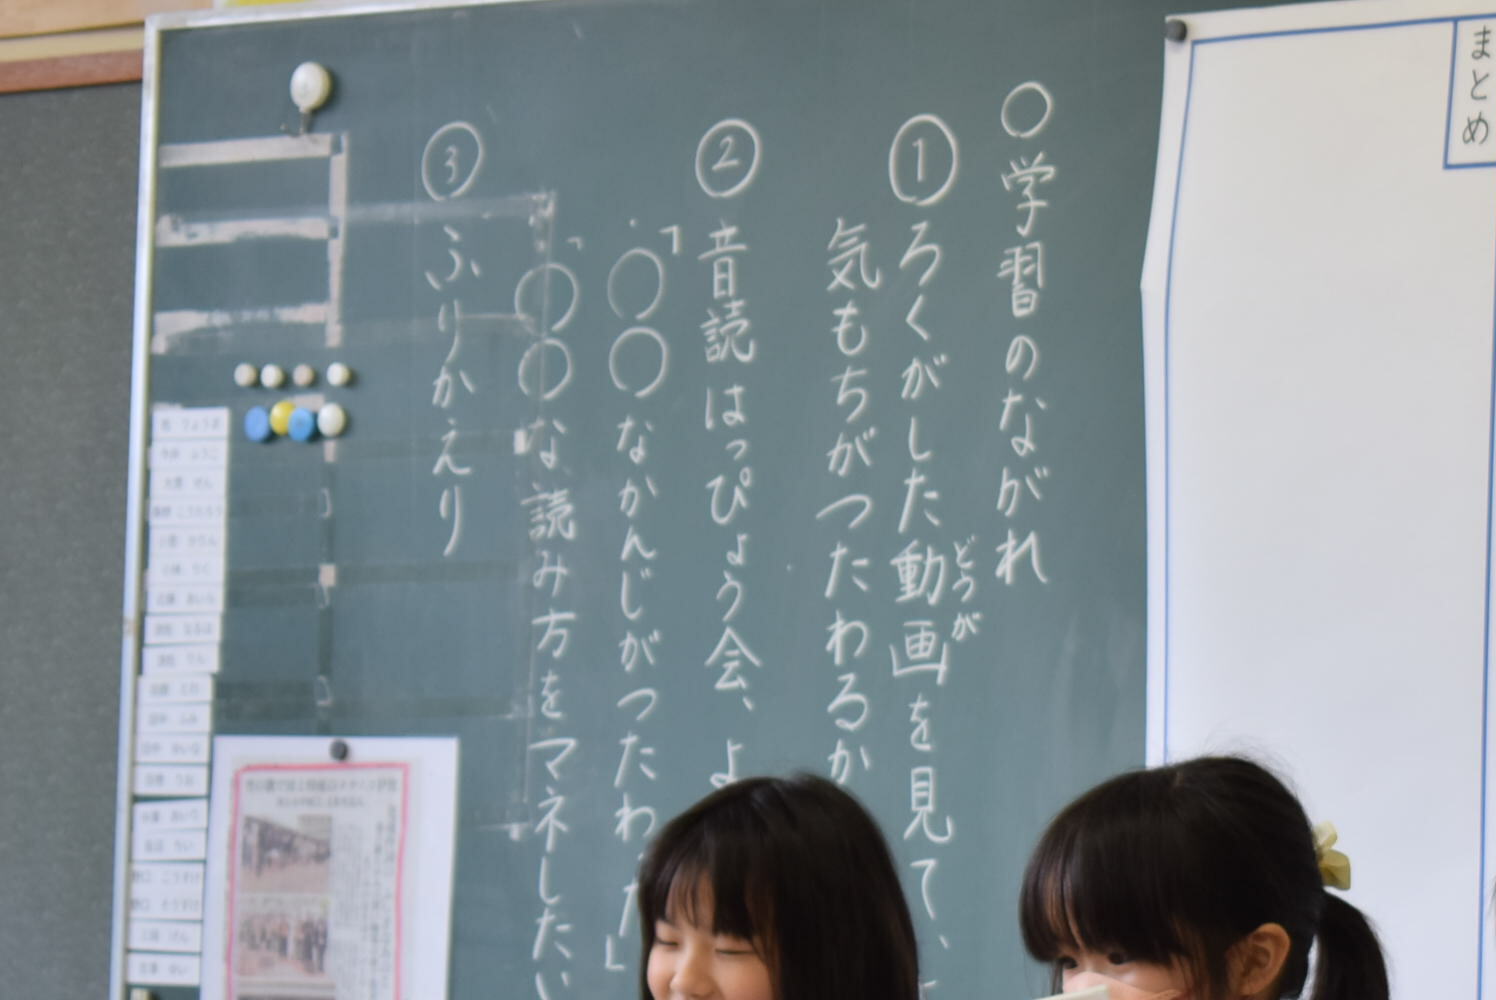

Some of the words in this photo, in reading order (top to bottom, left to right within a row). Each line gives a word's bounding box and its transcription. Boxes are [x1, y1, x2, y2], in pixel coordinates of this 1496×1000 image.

[1461, 25, 1492, 146] まとめ
[951, 533, 982, 642] どうが
